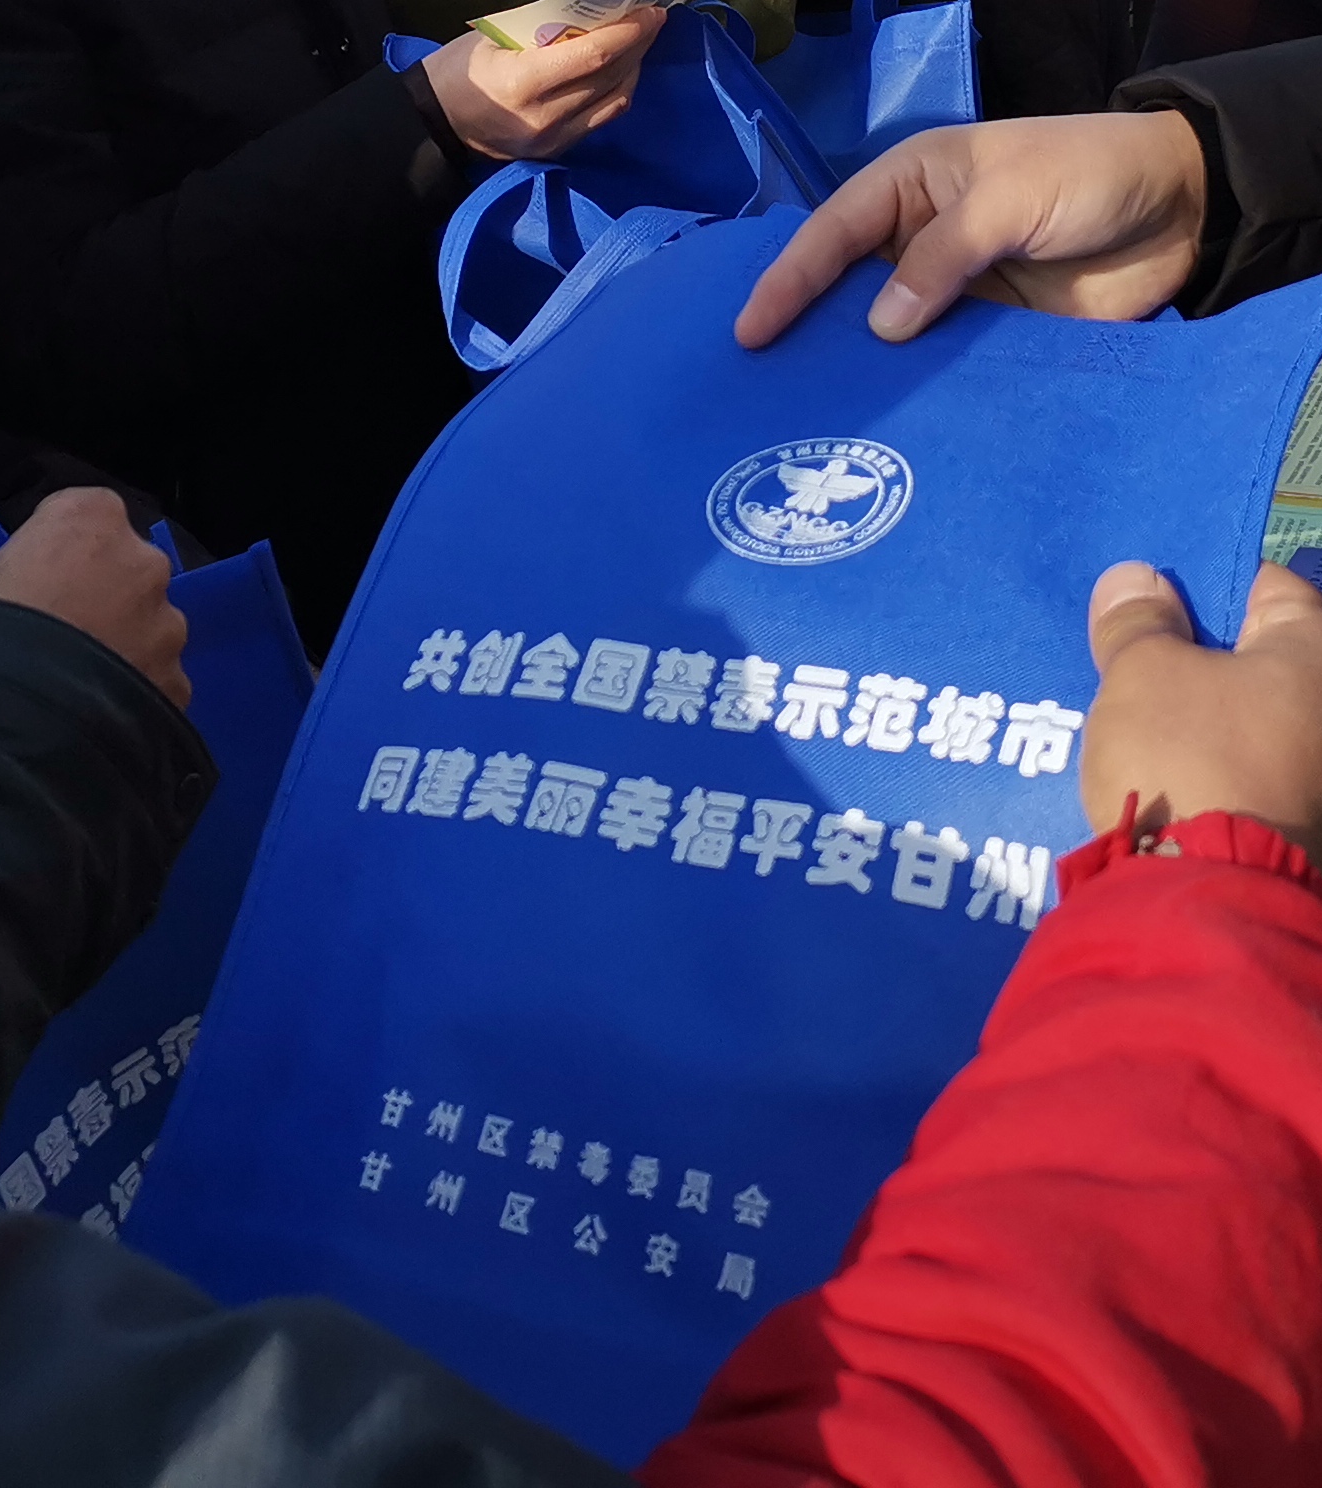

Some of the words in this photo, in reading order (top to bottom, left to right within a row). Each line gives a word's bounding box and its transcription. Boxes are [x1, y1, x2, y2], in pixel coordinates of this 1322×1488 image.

[403, 628, 1085, 778] 共创全国禁毒示范城市
[357, 744, 1053, 931] 同建美丽幸福平安甘州
[358, 1150, 757, 1301] 甘州区公安局
[380, 1086, 771, 1229] 甘州区禁毒委员会
